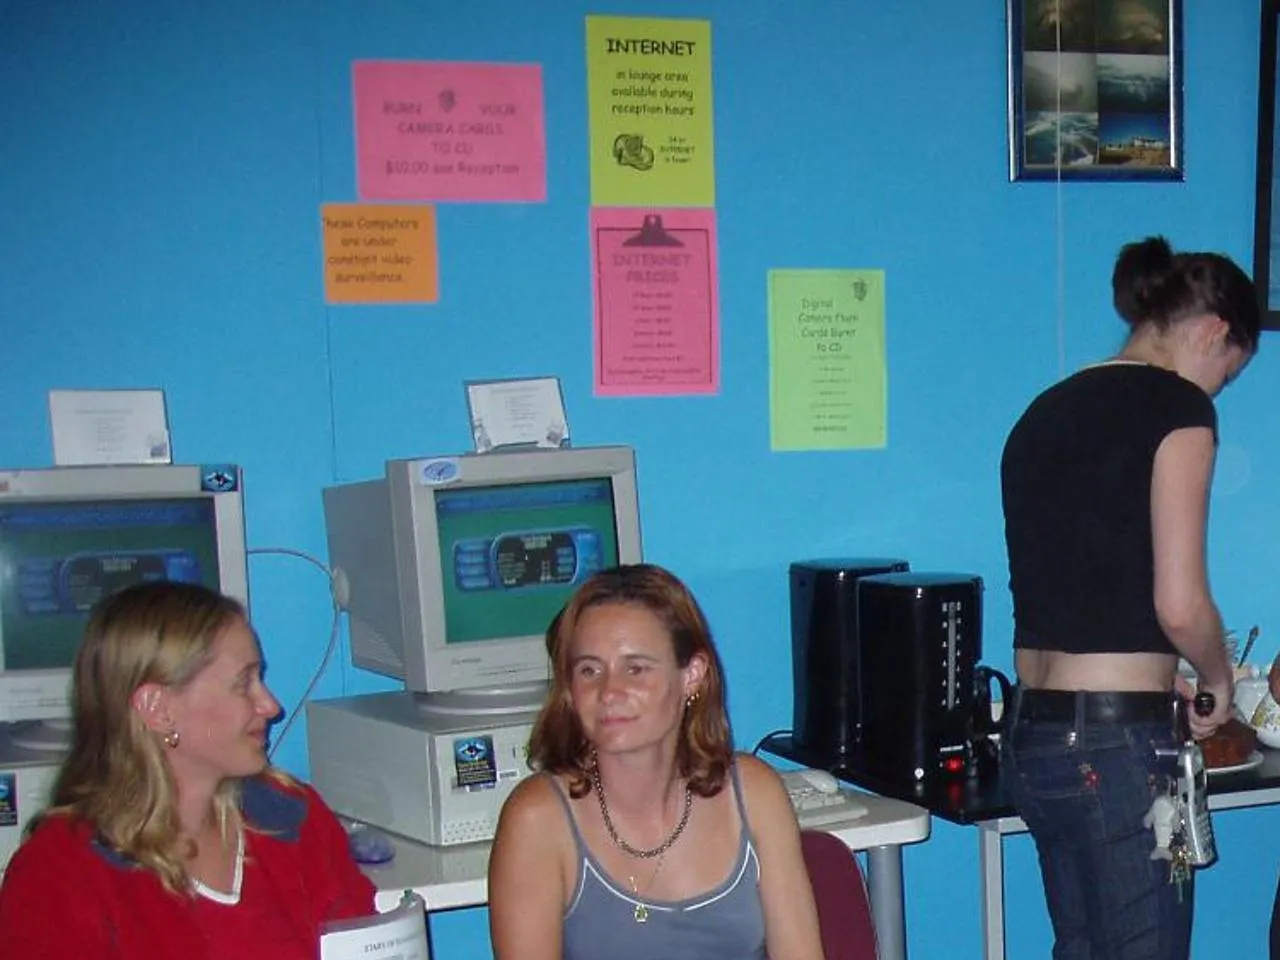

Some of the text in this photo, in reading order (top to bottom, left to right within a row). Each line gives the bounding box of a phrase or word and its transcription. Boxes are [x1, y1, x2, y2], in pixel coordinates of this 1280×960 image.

[606, 38, 696, 56] INTERNET
[629, 69, 661, 82] lounge
[611, 87, 693, 100] available during
[612, 104, 694, 115] reception hours
[398, 122, 454, 135] CAMERA
[364, 236, 398, 247] under
[327, 254, 378, 265] constant
[612, 253, 693, 267] INTERNET
